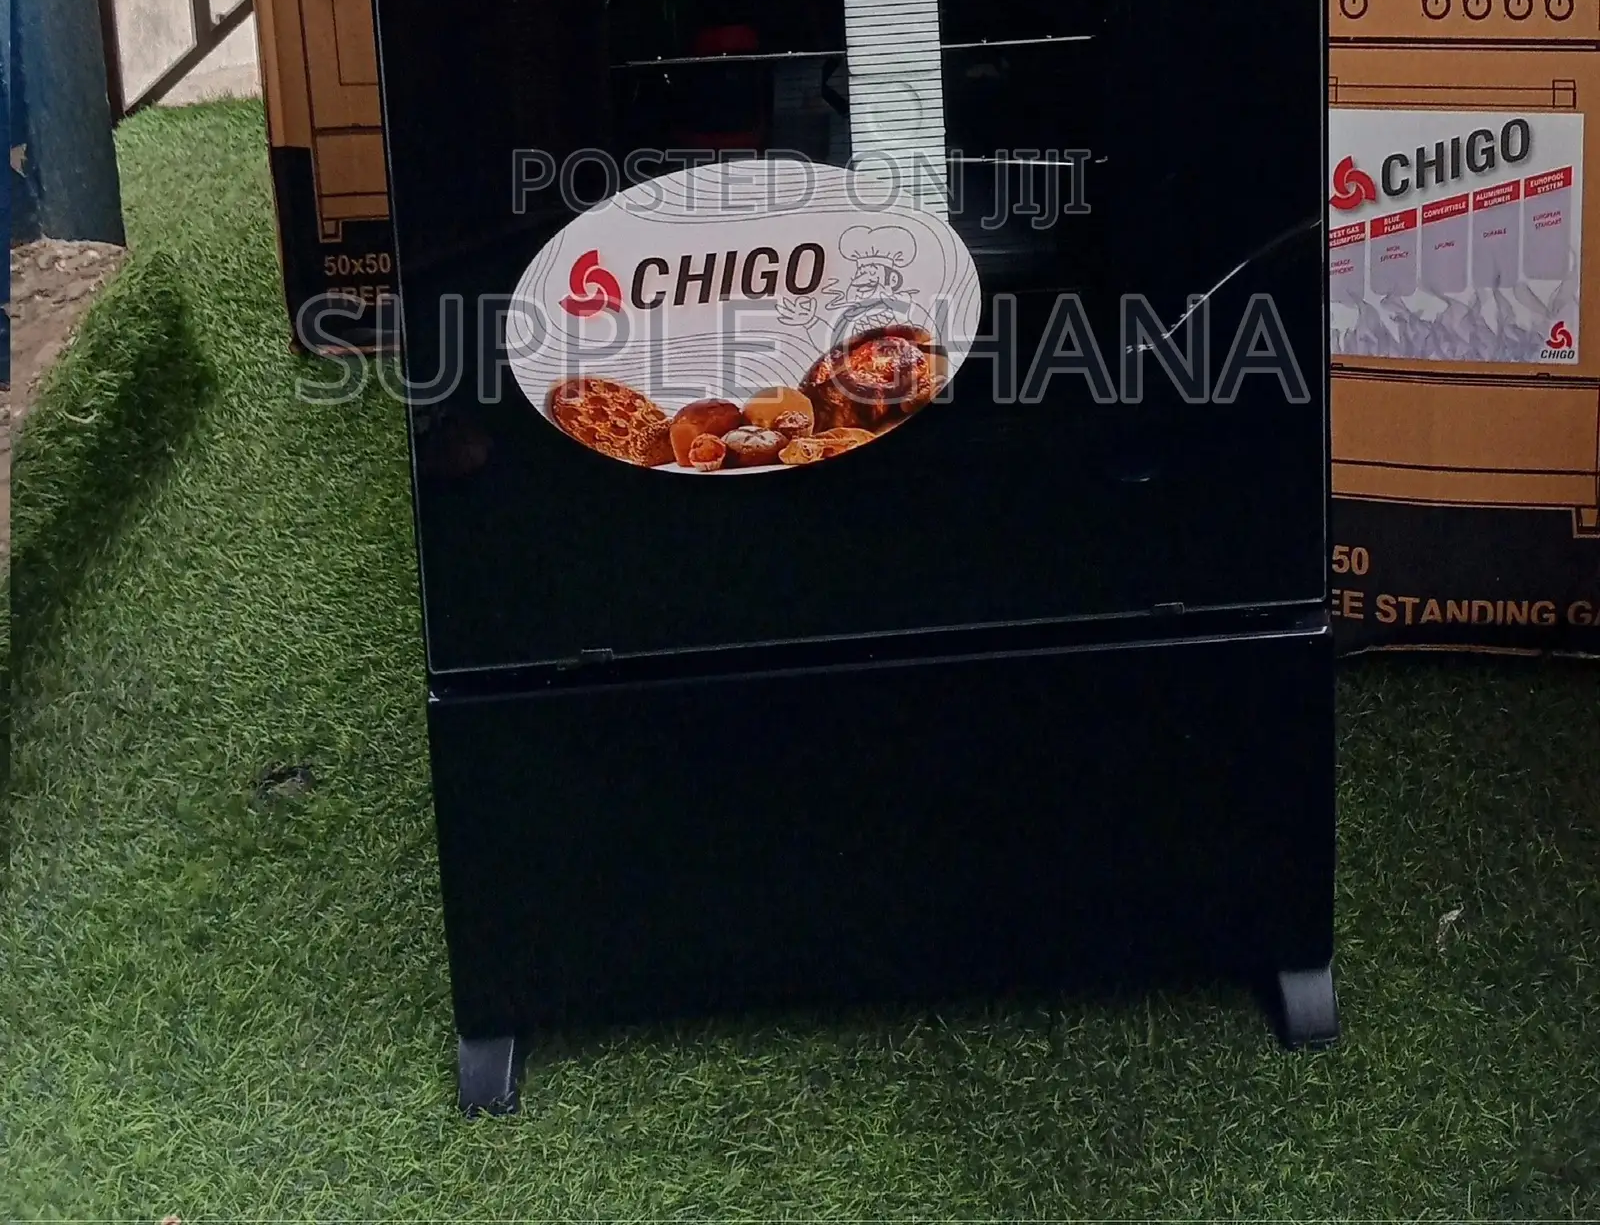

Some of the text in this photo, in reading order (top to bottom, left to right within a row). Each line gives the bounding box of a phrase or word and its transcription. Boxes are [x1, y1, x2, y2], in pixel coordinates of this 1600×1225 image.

[1381, 118, 1531, 197] CHIGO
[1537, 180, 1563, 193] SYSTEM
[1384, 215, 1400, 225] BLUE
[1423, 201, 1466, 220] CONVERTIBLE
[1346, 225, 1360, 235] GAS
[324, 253, 391, 276] 50x50
[631, 243, 825, 310] CHIGO
[326, 285, 392, 308] FREE
[1541, 349, 1575, 359] CHIGO
[1375, 593, 1556, 625] STANDING
